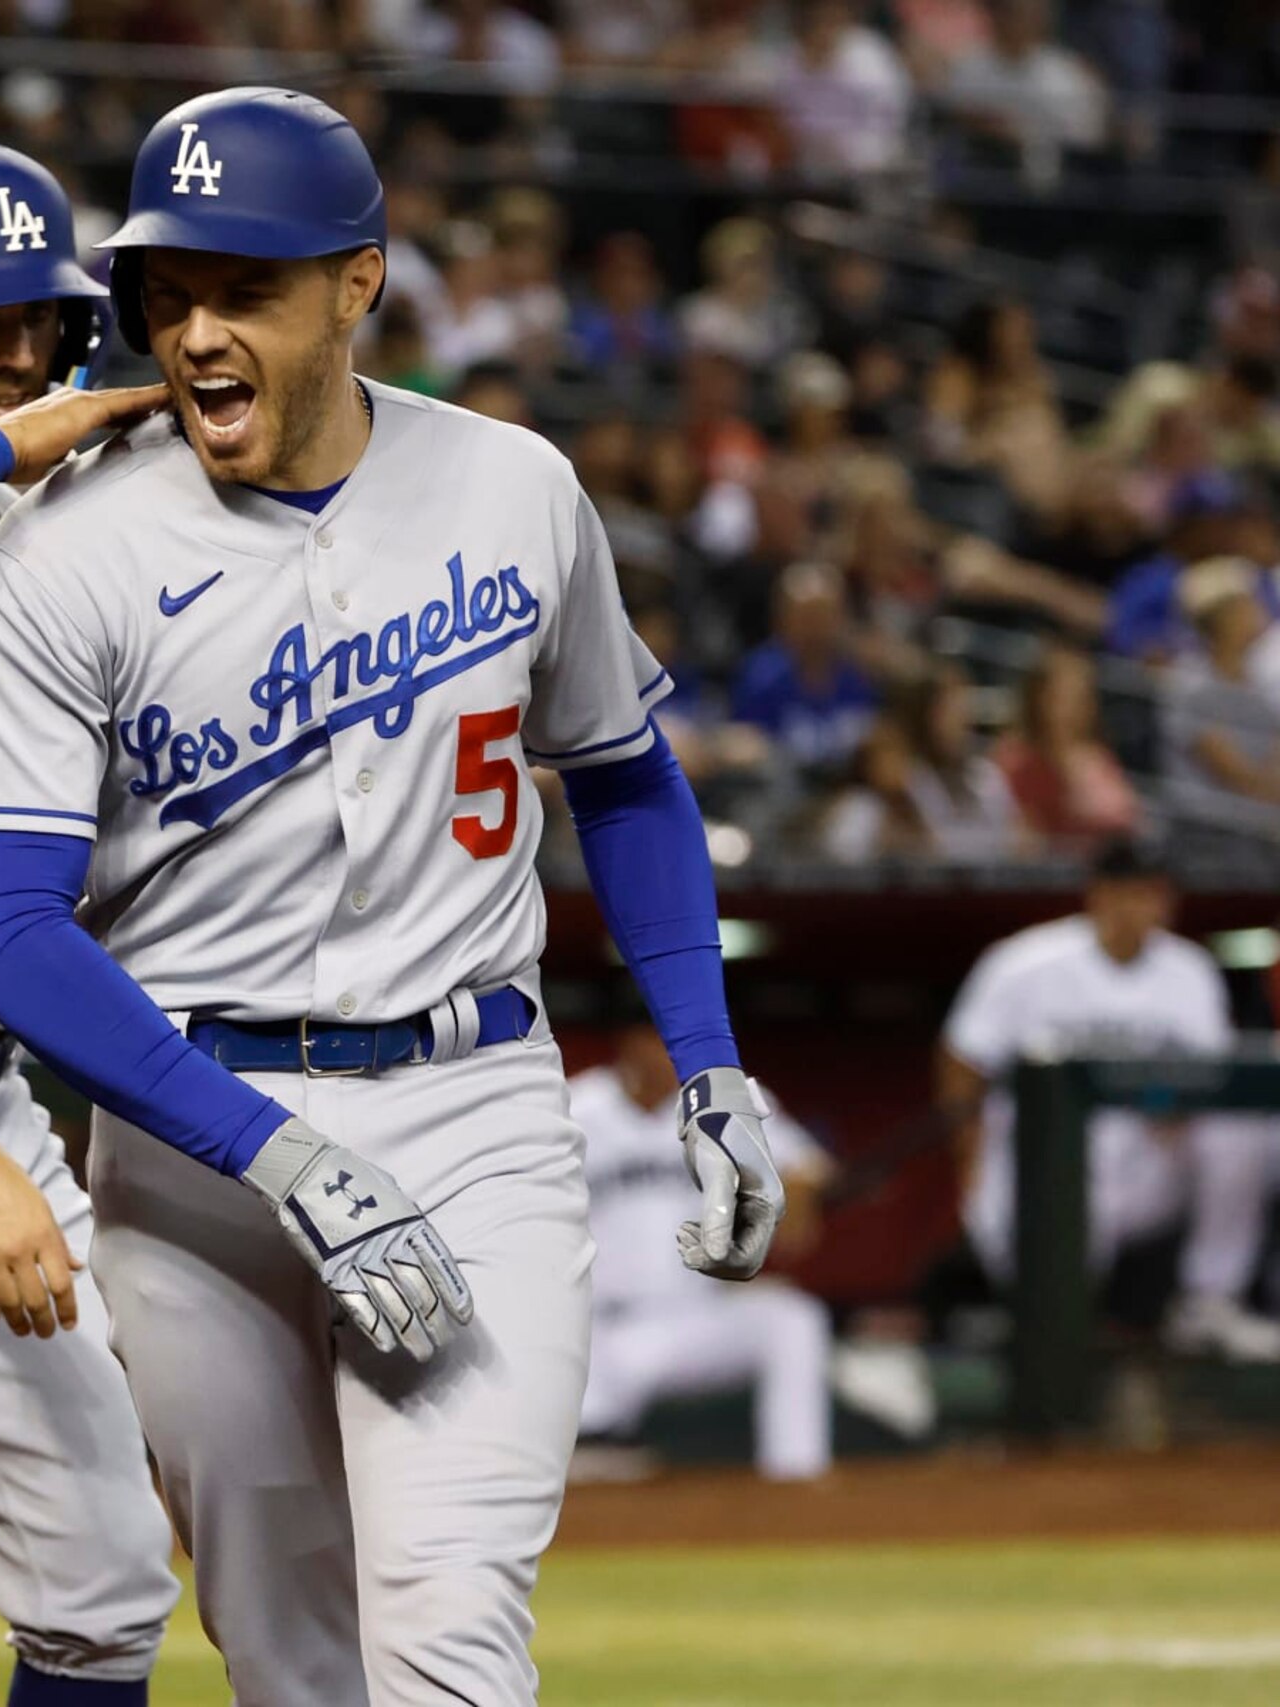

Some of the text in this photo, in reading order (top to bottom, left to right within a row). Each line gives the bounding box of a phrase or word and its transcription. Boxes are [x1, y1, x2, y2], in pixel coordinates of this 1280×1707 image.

[171, 123, 222, 196] LA
[120, 551, 540, 797] Los Angeles
[452, 703, 520, 860] 5
